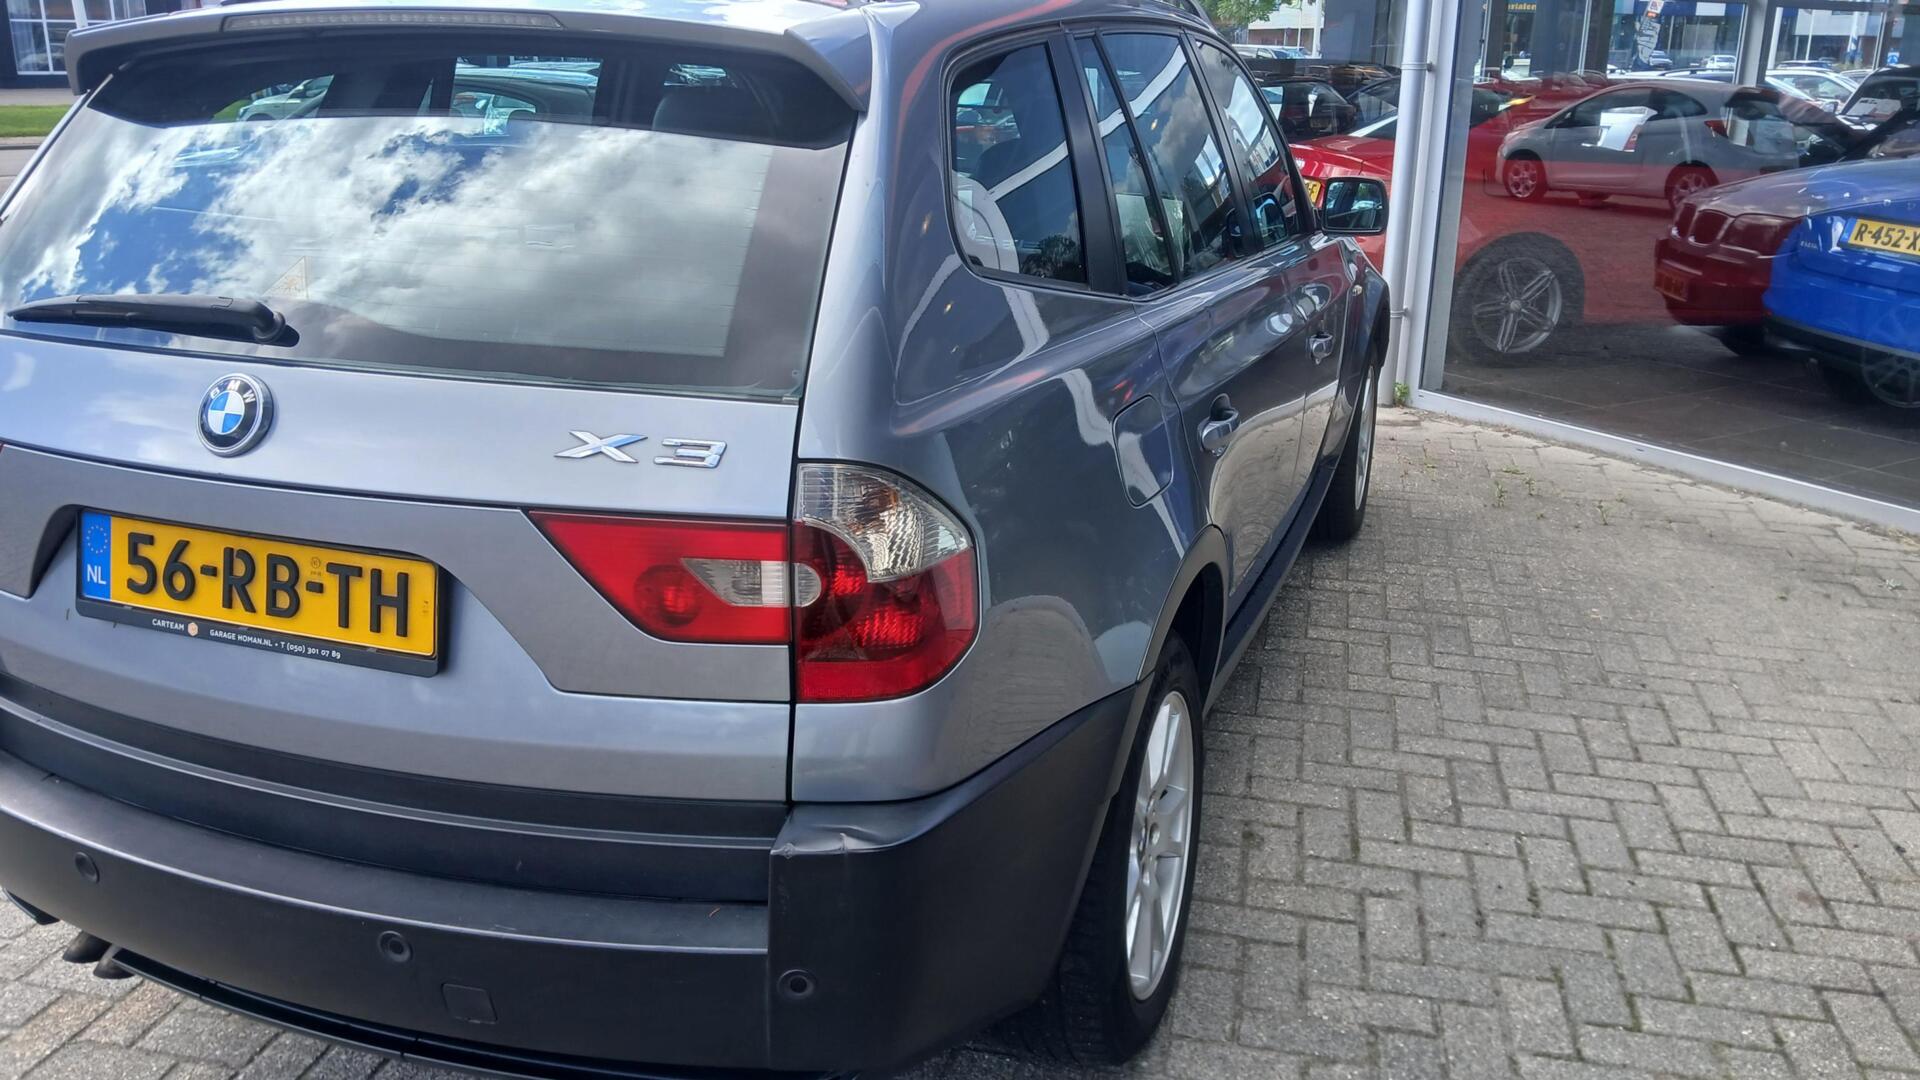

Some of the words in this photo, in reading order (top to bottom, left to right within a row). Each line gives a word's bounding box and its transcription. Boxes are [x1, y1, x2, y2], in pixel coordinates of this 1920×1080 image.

[1853, 223, 1920, 252] R-452-X
[210, 379, 257, 404] BMW
[553, 429, 728, 469] X3
[87, 563, 107, 585] NL
[126, 531, 409, 637] 56-RB-TH
[152, 618, 185, 631] CARTEAM
[209, 628, 236, 641] GARAGE
[287, 642, 306, 654] (050)
[307, 646, 319, 655] 301
[321, 649, 330, 657] 07
[331, 650, 341, 660] 89
